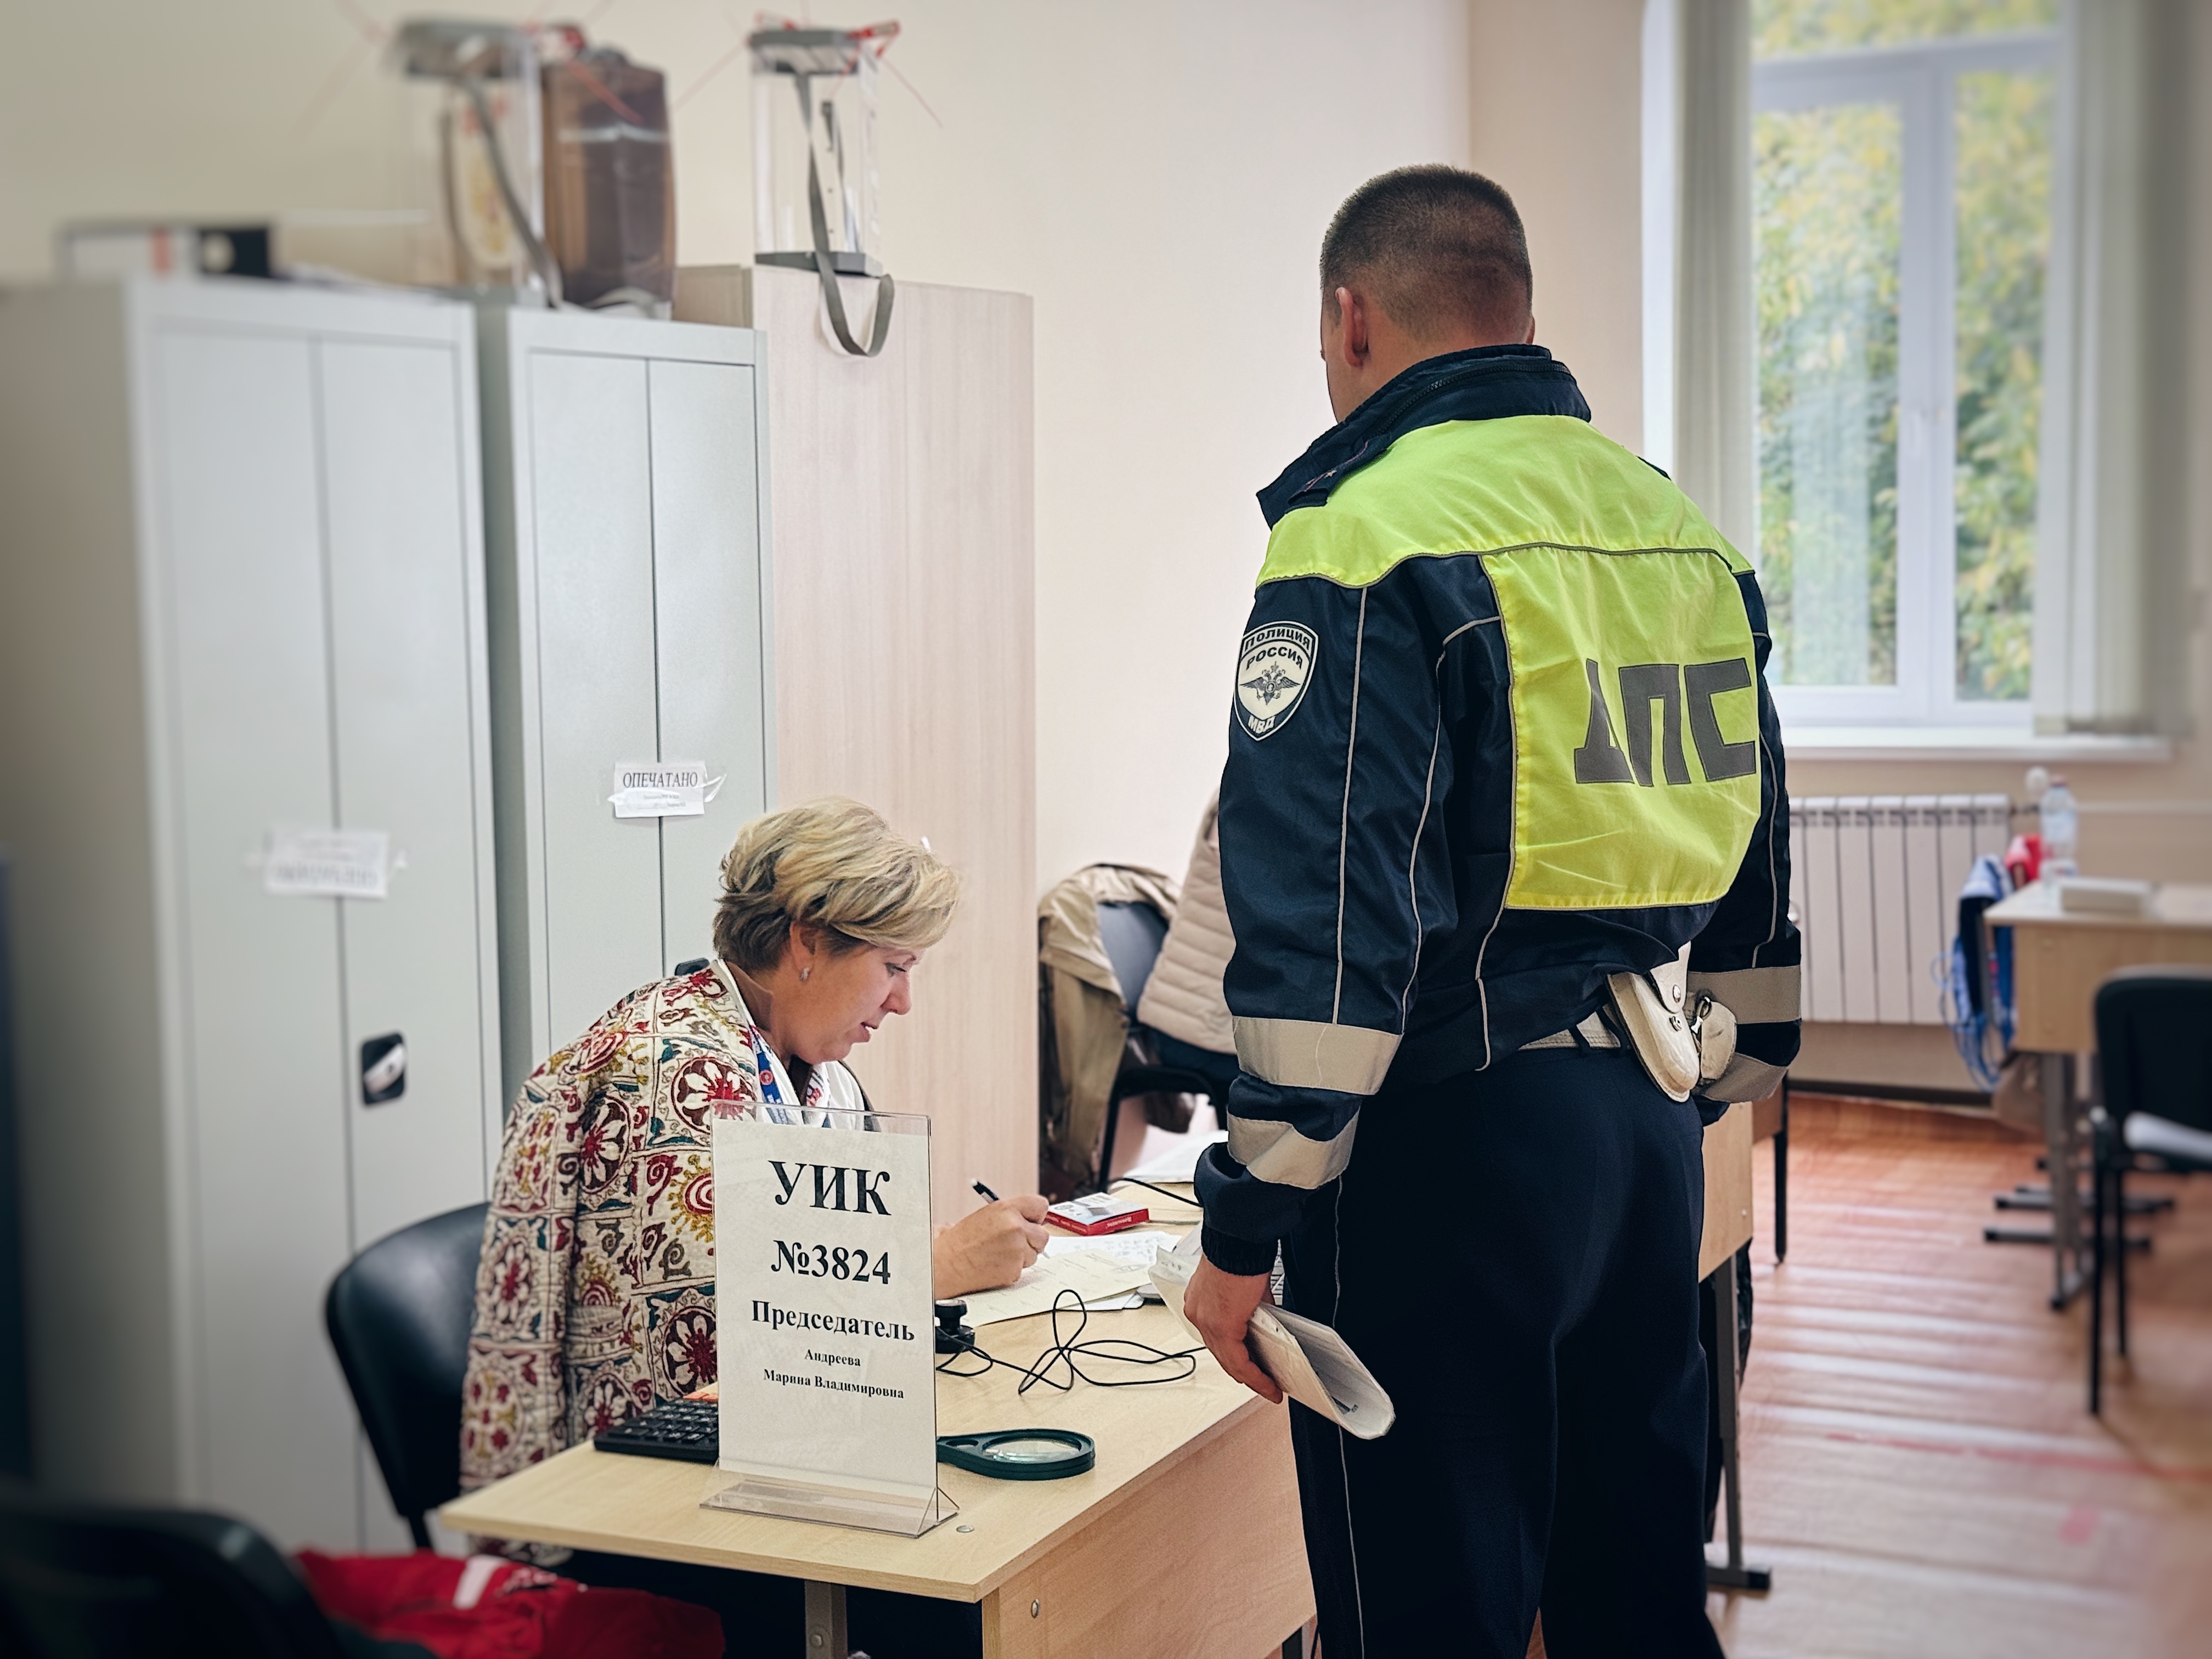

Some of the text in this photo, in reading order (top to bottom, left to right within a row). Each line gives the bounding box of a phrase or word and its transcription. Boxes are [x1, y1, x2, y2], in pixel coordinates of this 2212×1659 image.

[1245, 628, 1310, 651] ПОЛИЦИЯ
[1245, 646, 1303, 671] РОССИЯ
[1248, 715, 1276, 733] МВД
[623, 772, 698, 788] ОПЕЧАТАНО
[768, 1160, 891, 1216] УИК
[771, 1240, 891, 1284] №3824
[752, 1300, 915, 1341] Председатель
[804, 1349, 861, 1367] Андреева
[763, 1369, 904, 1399] Марина Владимировна
